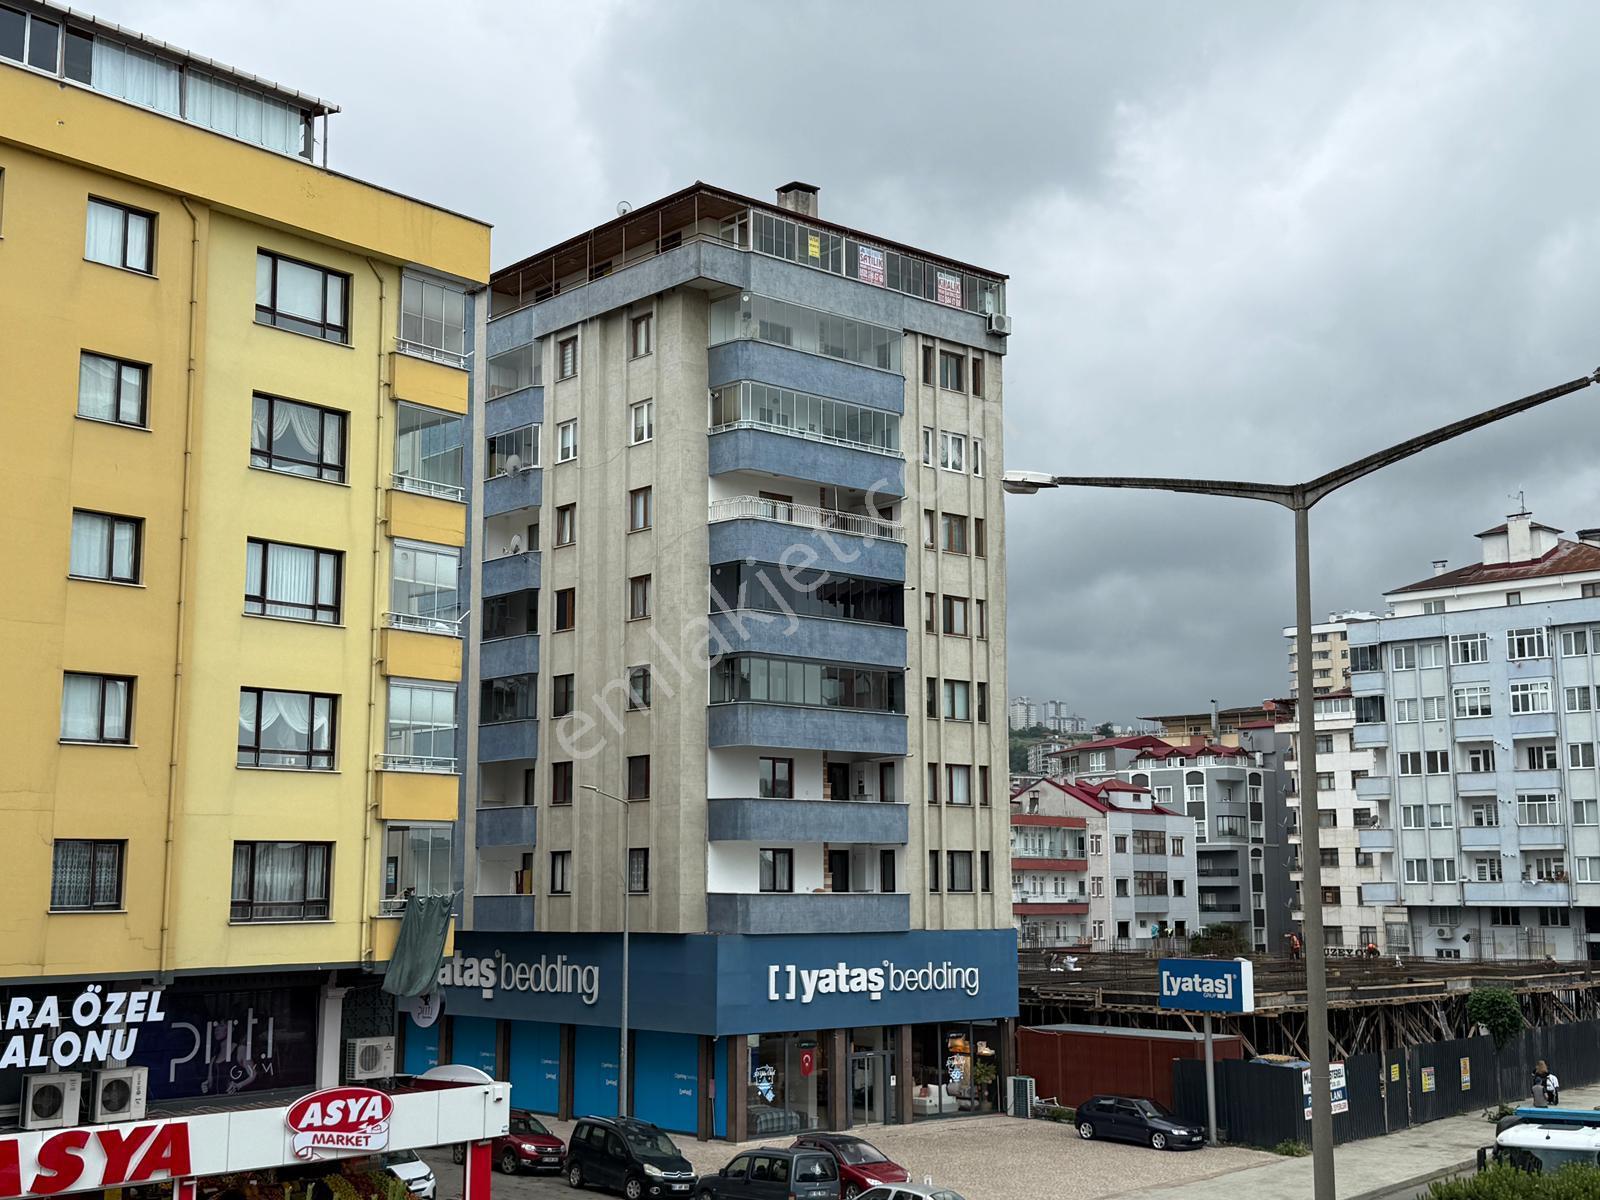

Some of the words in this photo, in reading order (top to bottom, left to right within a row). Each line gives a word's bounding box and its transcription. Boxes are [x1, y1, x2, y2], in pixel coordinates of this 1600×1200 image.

[437, 950, 497, 999] ataş
[501, 953, 599, 1005] bedding
[800, 962, 885, 1003] yataş
[889, 961, 979, 996] bedding
[0, 996, 60, 1030] RA
[72, 984, 165, 1027] ÖZEL
[298, 1096, 383, 1128] ASYA
[312, 1133, 372, 1148] MARKET
